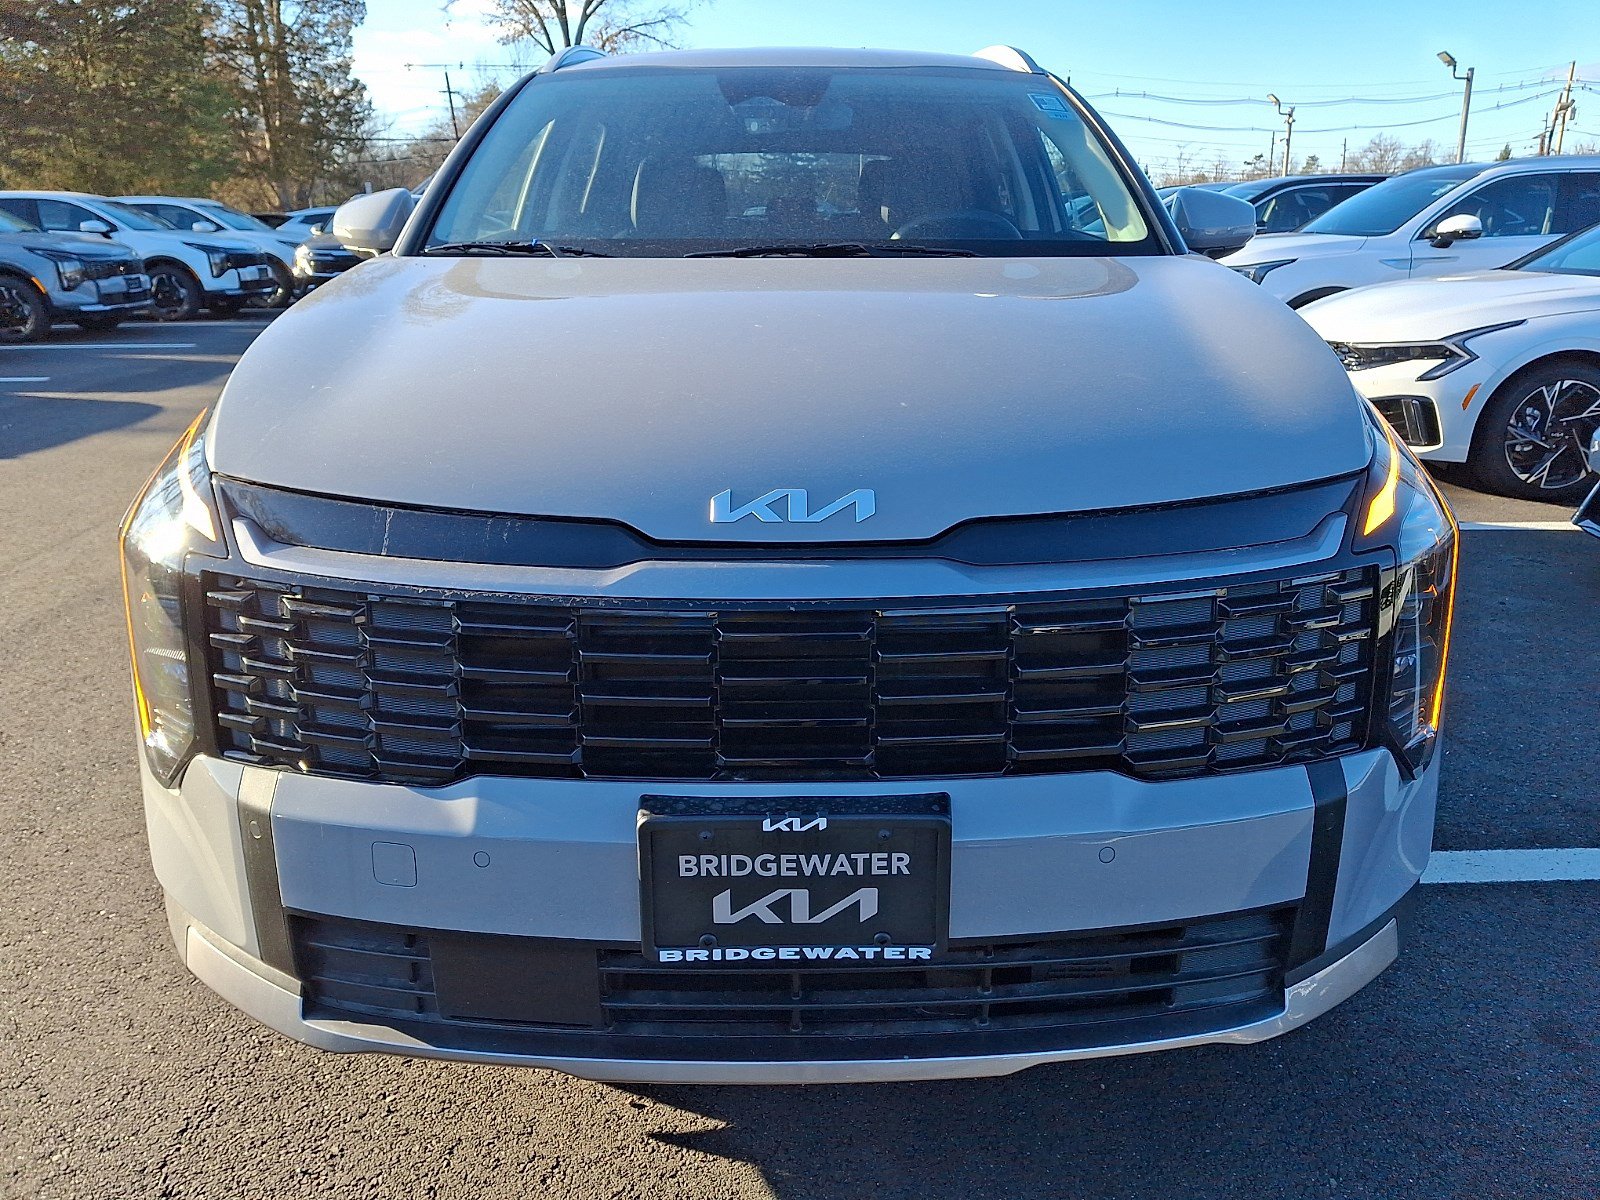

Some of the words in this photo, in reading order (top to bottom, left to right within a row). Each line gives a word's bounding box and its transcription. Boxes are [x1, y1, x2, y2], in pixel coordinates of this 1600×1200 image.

[709, 488, 876, 523] KIA
[762, 817, 827, 832] KIA
[678, 852, 911, 878] BRIDGEWATER
[712, 887, 879, 924] KIA
[658, 946, 932, 962] BRIDGEWATER
